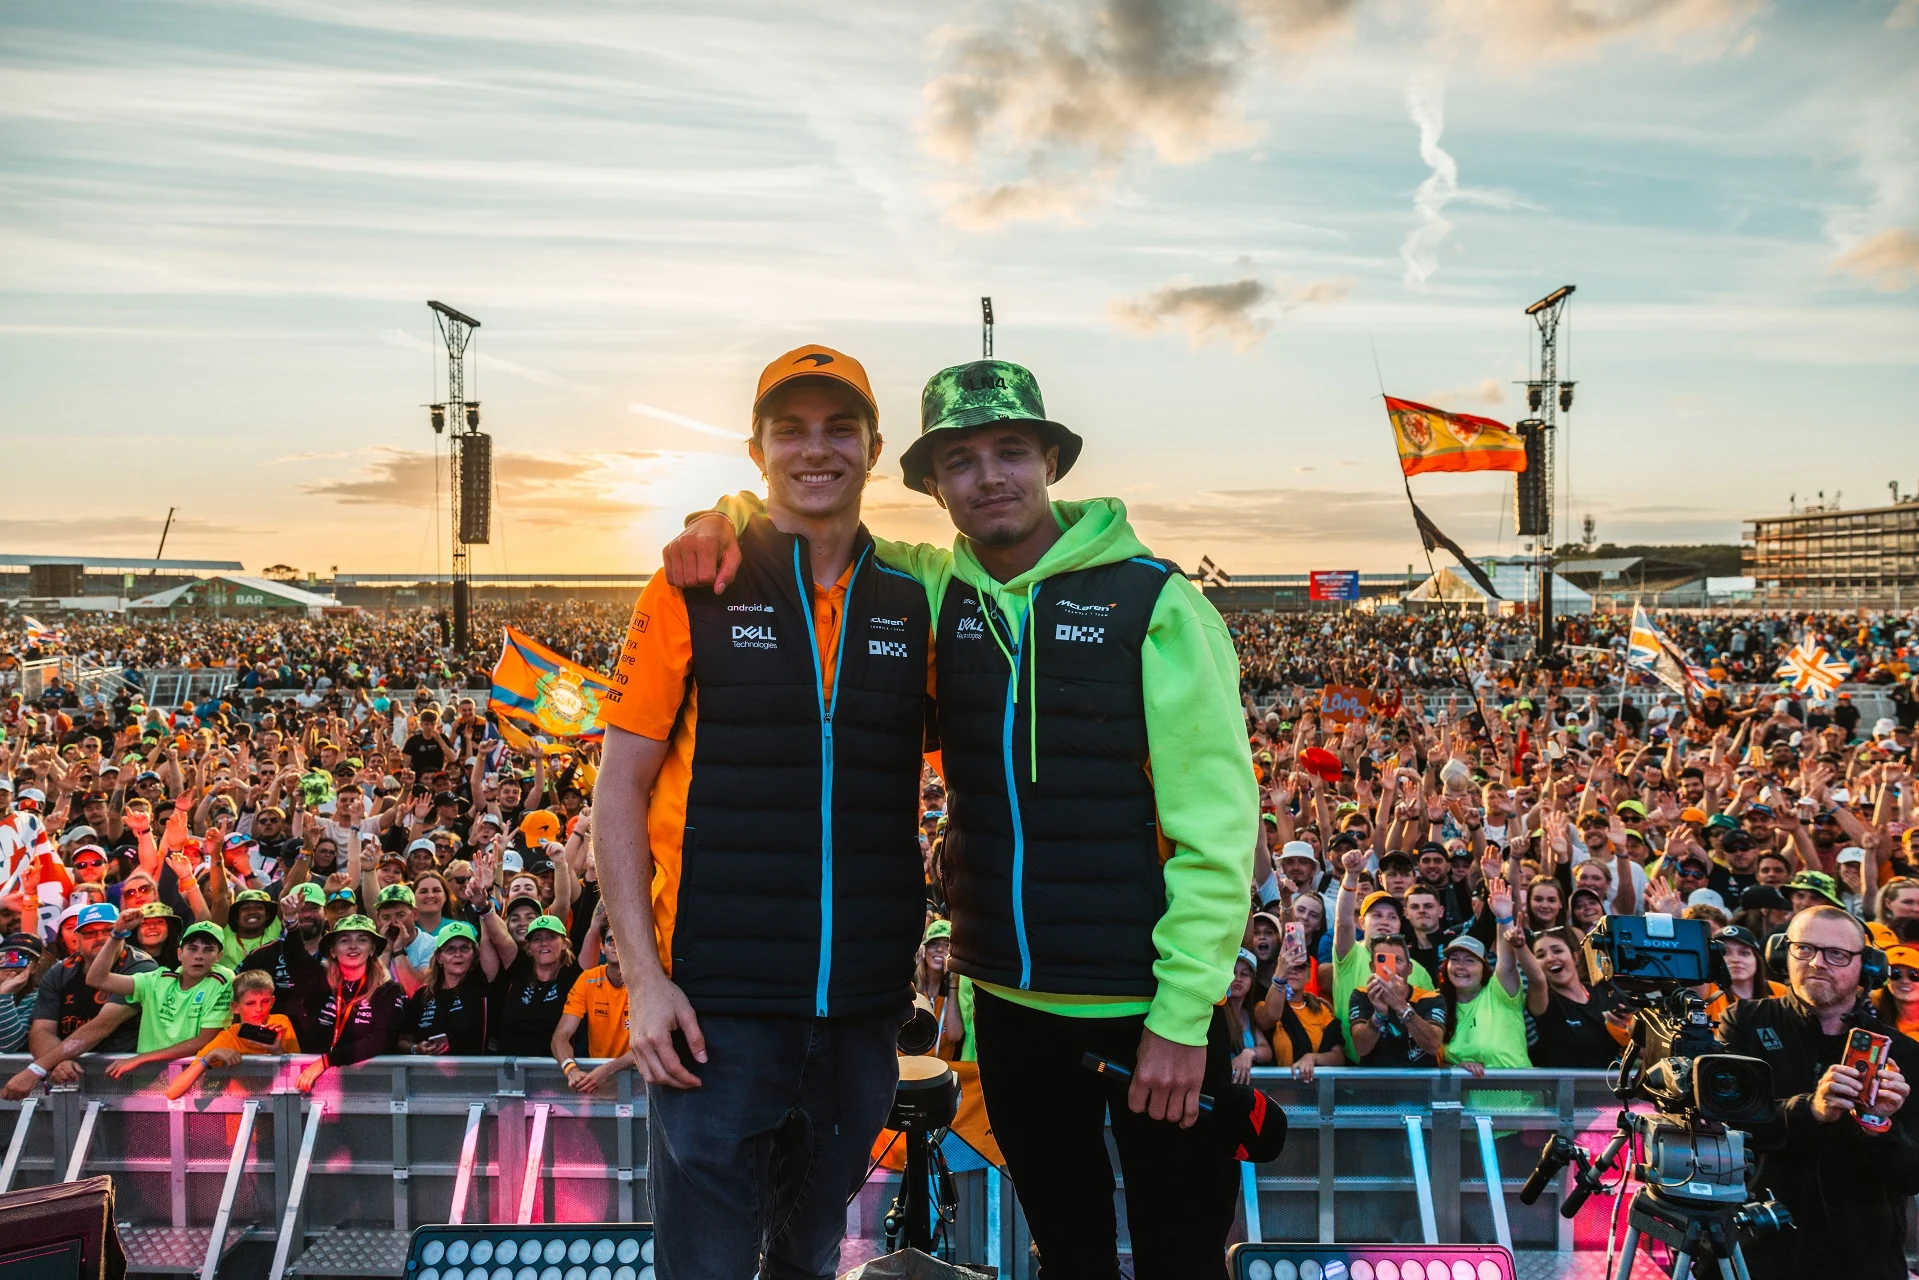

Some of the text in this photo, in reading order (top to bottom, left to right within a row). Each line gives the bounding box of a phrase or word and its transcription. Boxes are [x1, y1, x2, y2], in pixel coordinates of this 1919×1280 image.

[235, 594, 264, 605] BAR
[1055, 599, 1110, 612] McLaren
[727, 603, 763, 613] android
[957, 616, 985, 632] DELL
[731, 625, 777, 640] DELL
[1055, 623, 1105, 644] OKX
[732, 640, 778, 650] Technologies
[868, 639, 908, 658] OKX
[1643, 939, 1680, 949] SONY
[1761, 1029, 1775, 1044] 4
